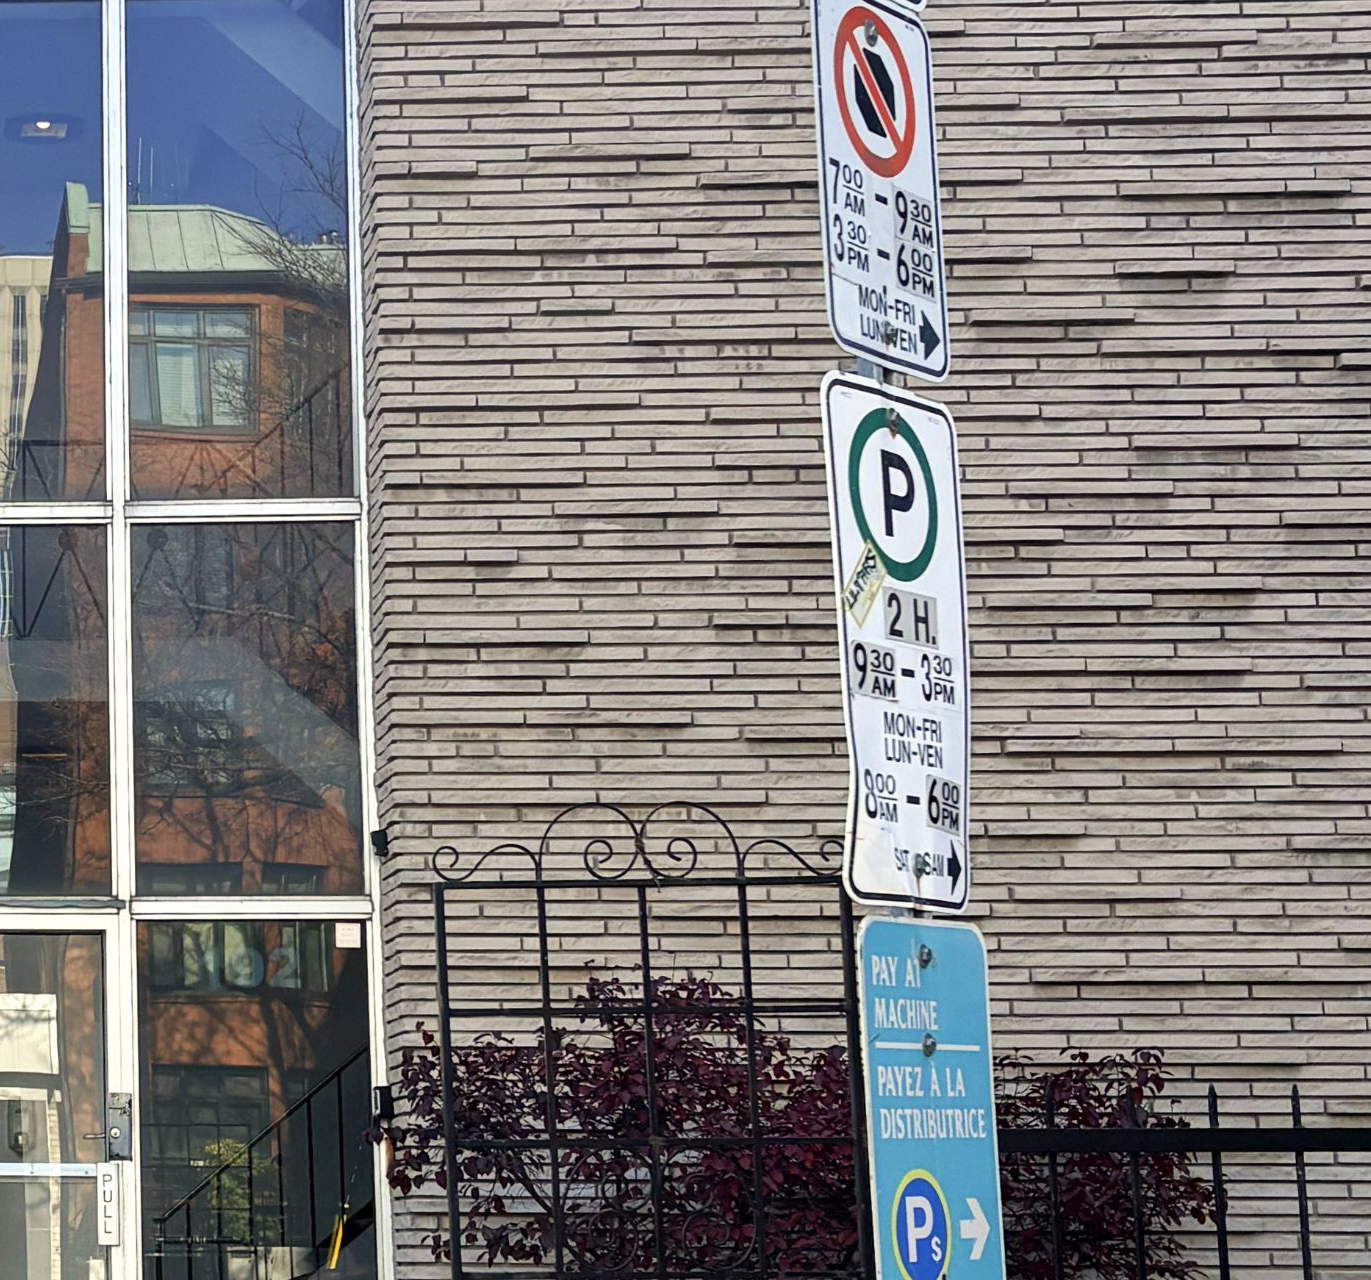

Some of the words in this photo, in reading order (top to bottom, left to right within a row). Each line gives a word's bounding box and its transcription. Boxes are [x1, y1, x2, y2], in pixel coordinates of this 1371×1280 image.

[844, 192, 865, 217] AM
[912, 224, 933, 248] AM
[848, 247, 869, 272] PM
[912, 273, 934, 297] PM
[880, 449, 915, 537] P
[887, 592, 903, 638] 2
[871, 676, 896, 698] AM
[934, 682, 955, 705] PM
[883, 711, 943, 743] MON-FRI
[884, 738, 943, 769] LUN-VEN
[879, 802, 898, 823] AM
[942, 808, 960, 831] PM
[871, 954, 898, 987] PAY
[874, 997, 938, 1031] MACHINE
[877, 1066, 924, 1097] PAYEZ
[930, 1061, 941, 1097] À
[946, 1068, 966, 1097] LA
[880, 1108, 986, 1140] DISTRIBUTRICE
[102, 1174, 112, 1234] PULL
